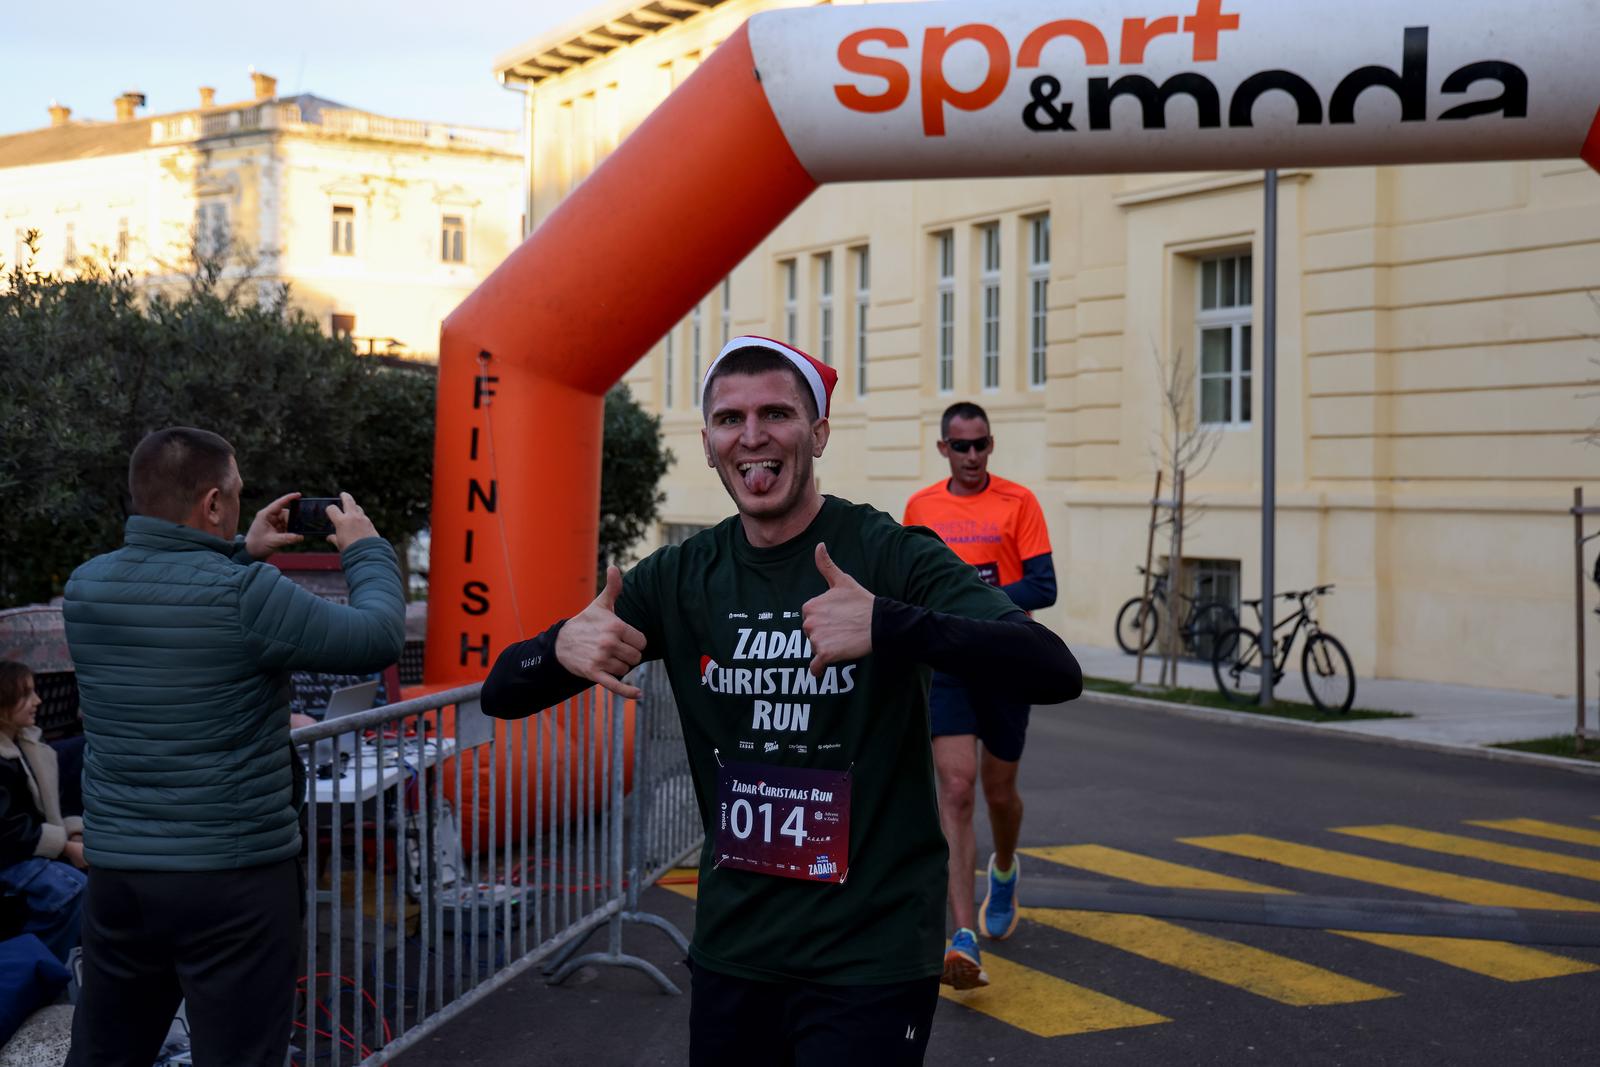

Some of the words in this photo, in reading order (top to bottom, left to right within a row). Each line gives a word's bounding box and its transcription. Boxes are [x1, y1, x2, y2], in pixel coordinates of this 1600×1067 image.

[834, 0, 1240, 137] sport
[459, 375, 499, 668] FINISH
[732, 628, 812, 660] ZADA
[521, 655, 542, 669] KIPSTA
[707, 664, 857, 695] CHRISTMAS
[752, 700, 811, 732] RUN
[732, 779, 757, 795] ZADAR
[759, 781, 809, 801] CHRISTMAS
[810, 788, 833, 803] RUN
[730, 798, 808, 847] 014
